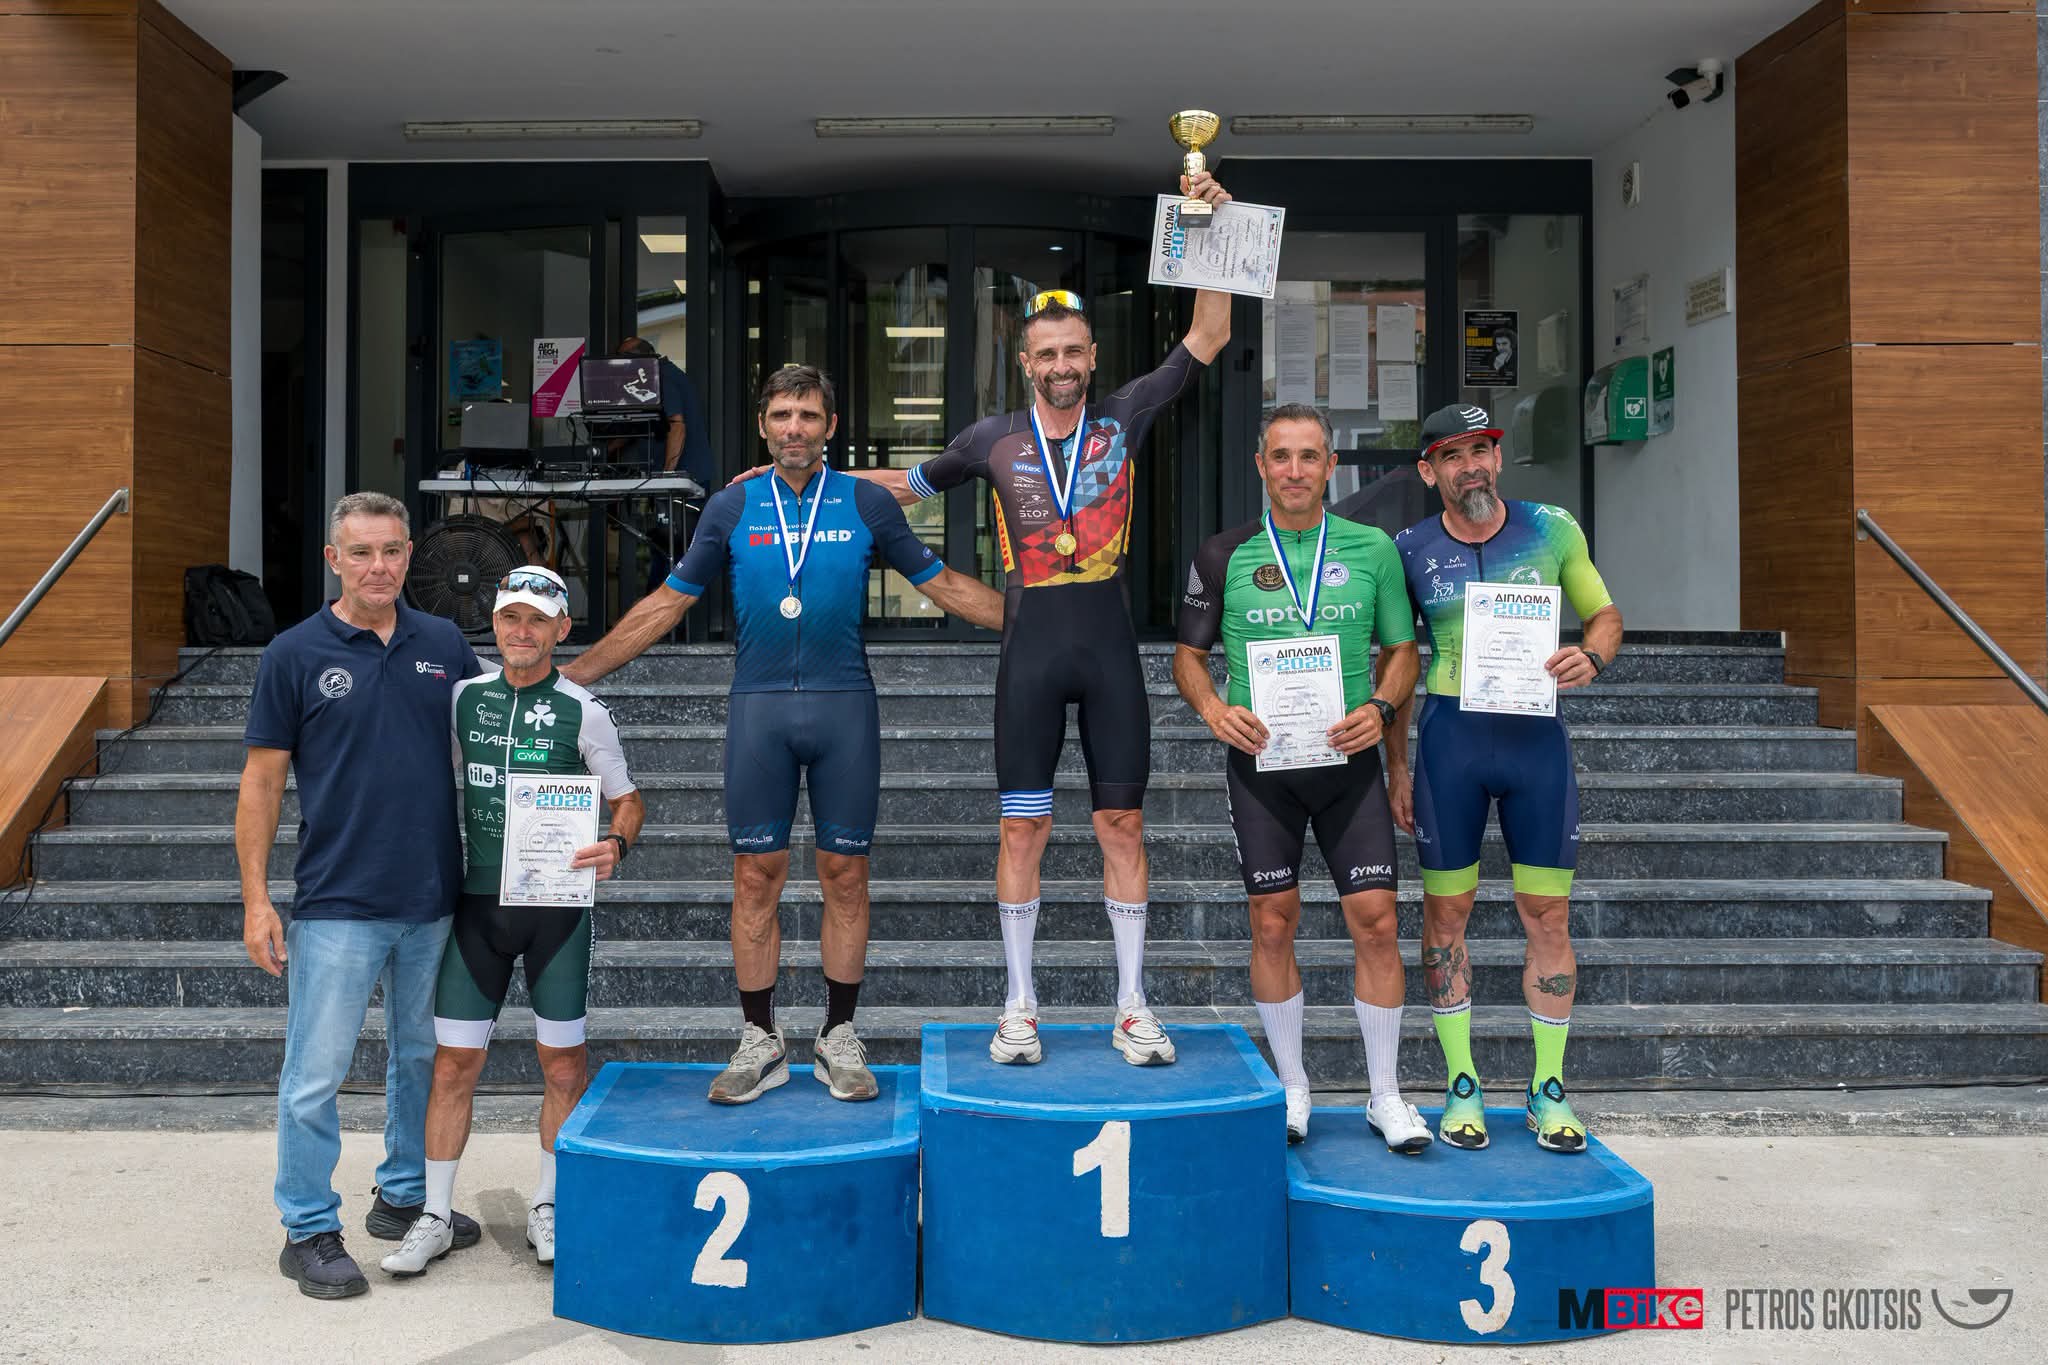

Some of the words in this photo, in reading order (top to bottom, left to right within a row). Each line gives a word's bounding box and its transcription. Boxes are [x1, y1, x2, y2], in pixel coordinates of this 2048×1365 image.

[1015, 464, 1041, 473] vitex
[1495, 593, 1551, 605] ΔΙΠΛΩΜΑ
[1493, 603, 1551, 617] 2026
[1276, 646, 1331, 659] ΔΙΠΛΩΜΑ
[1276, 656, 1332, 671] 2026
[469, 730, 554, 750] DIAPLASI
[517, 751, 545, 761] GYM
[537, 784, 592, 795] ΔΙΠΛΩΜΑ
[536, 792, 592, 807] 2026
[1253, 866, 1292, 883] SYNKA
[1350, 865, 1392, 880] SYNKA
[1073, 1120, 1131, 1239] 1
[692, 1171, 750, 1288] 2
[1459, 1219, 1516, 1335] 3
